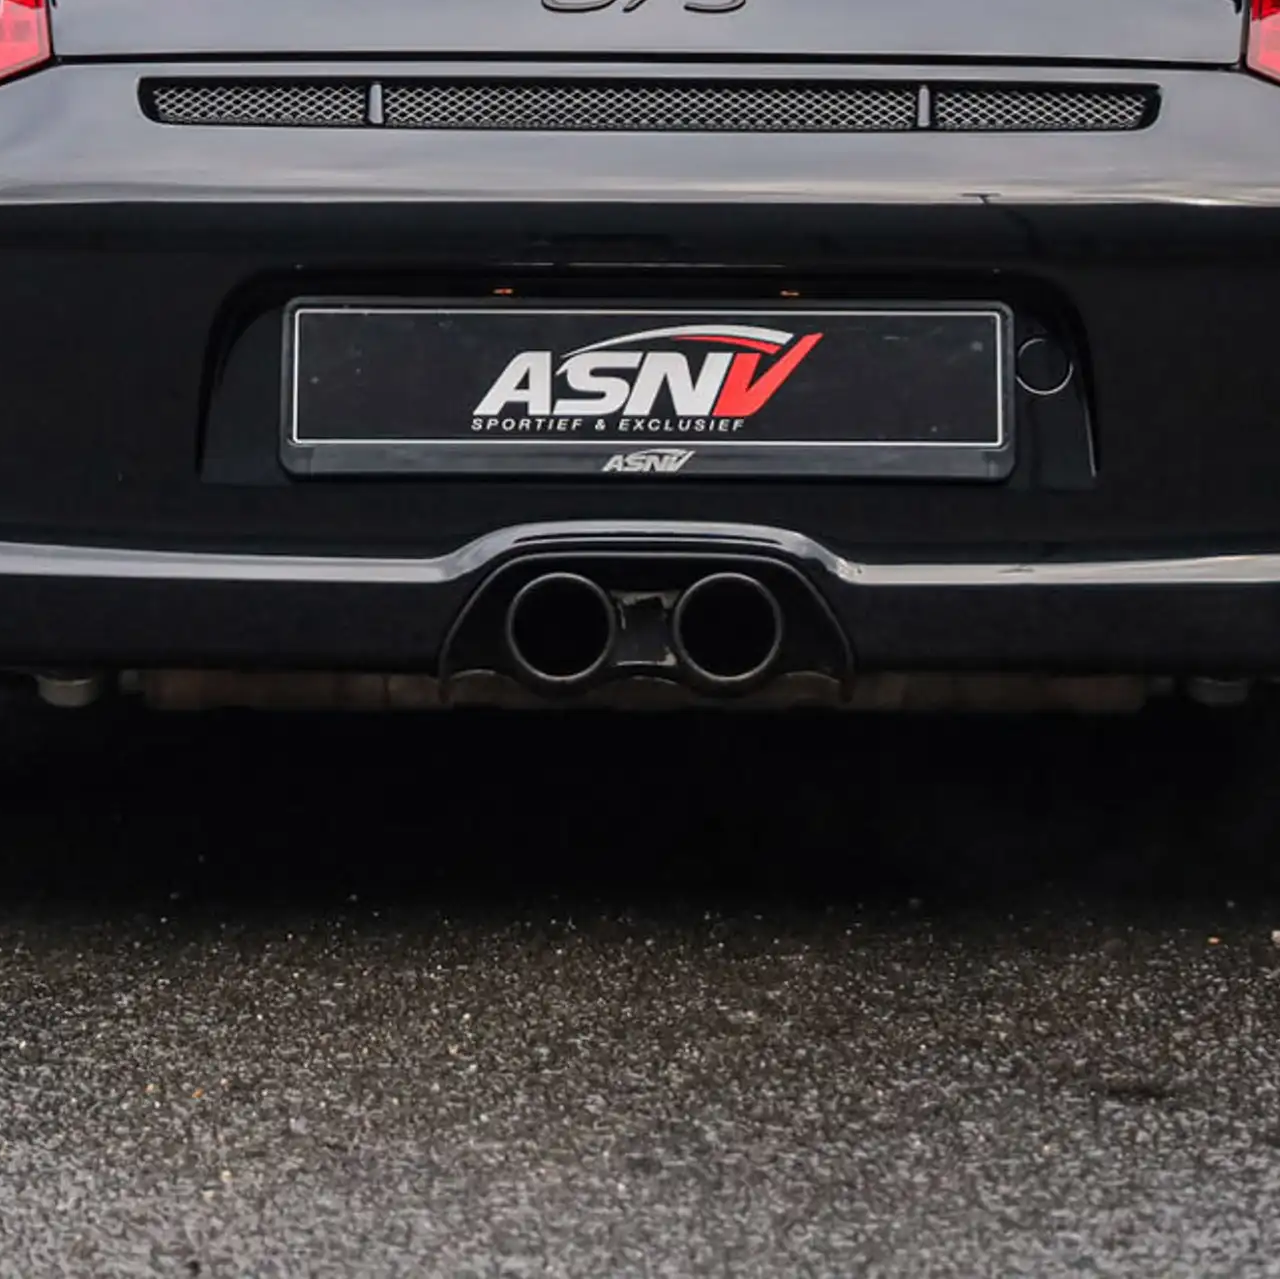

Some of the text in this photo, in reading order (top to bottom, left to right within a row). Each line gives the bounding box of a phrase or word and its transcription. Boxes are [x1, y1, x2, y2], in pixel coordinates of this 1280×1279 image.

[470, 418, 746, 431] SPORTIEF & EXCLUSIEF
